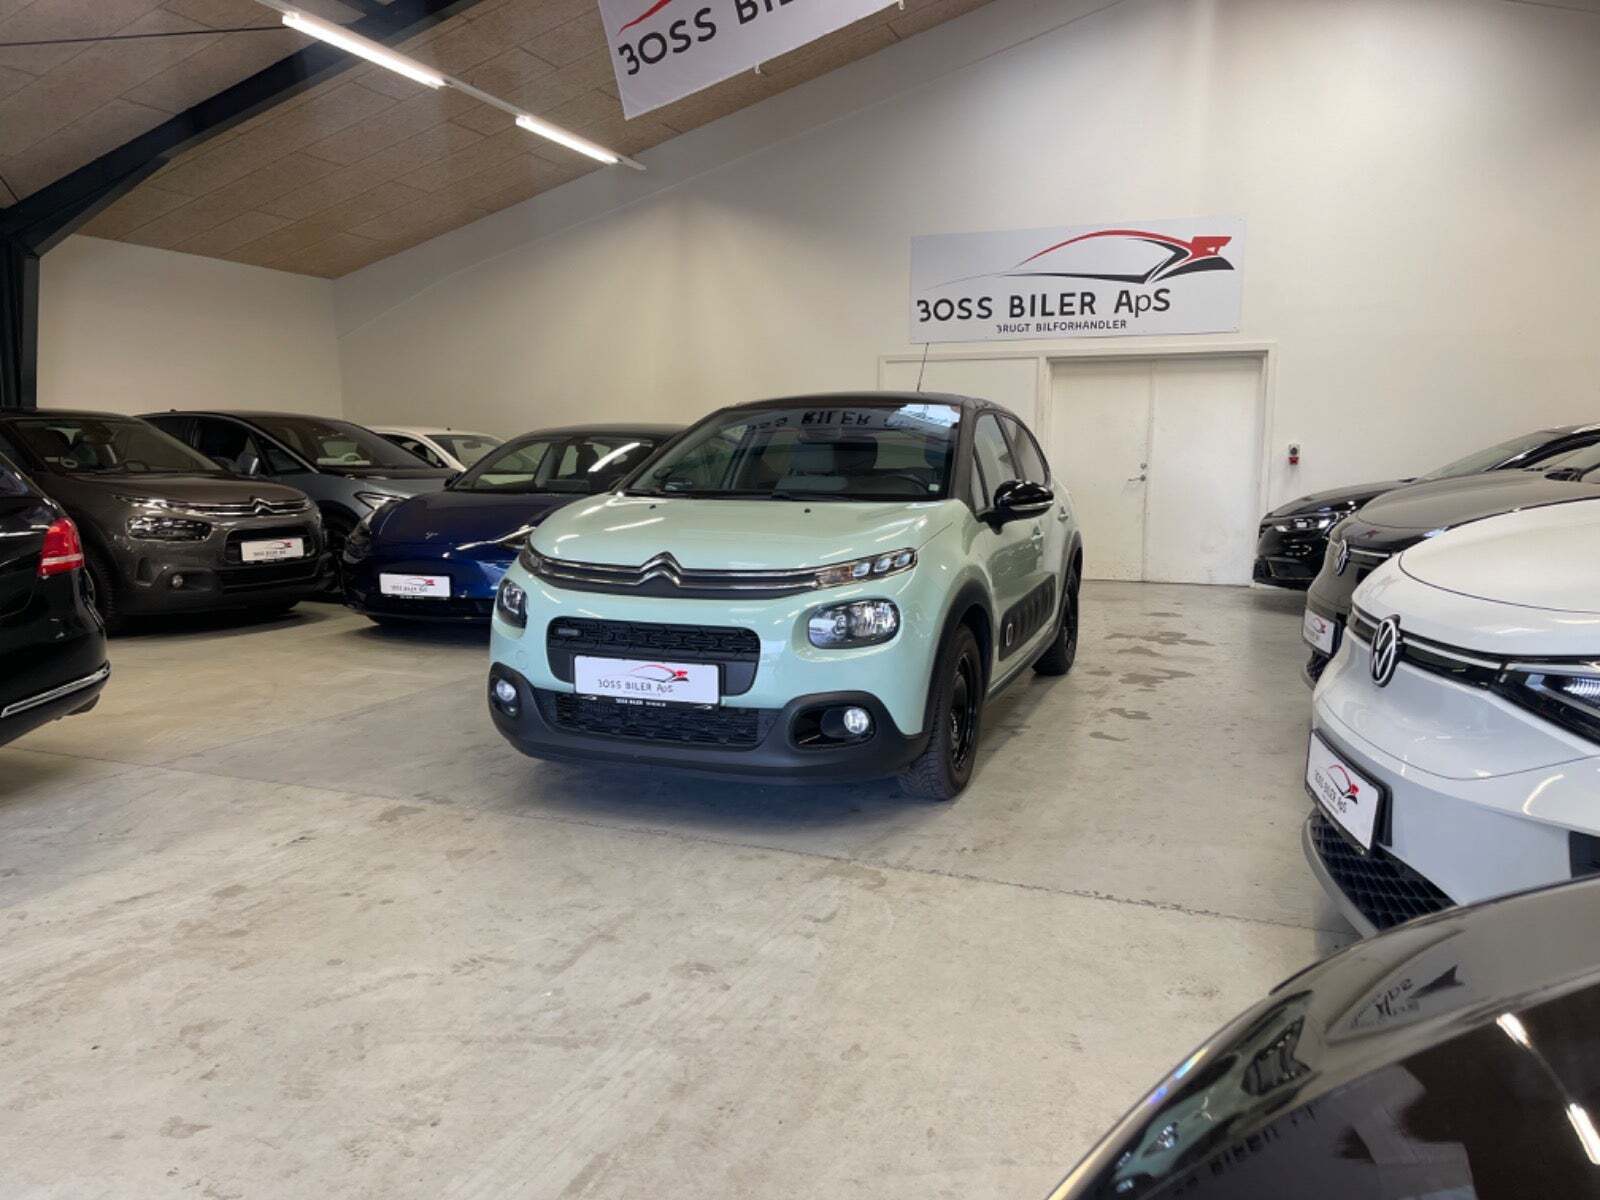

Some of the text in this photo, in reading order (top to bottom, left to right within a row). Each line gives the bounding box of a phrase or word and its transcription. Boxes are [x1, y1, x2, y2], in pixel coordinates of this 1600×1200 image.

[1009, 291, 1096, 319] BILER
[1113, 288, 1171, 318] ApS
[1035, 319, 1127, 333] BILFORHANDLER
[625, 681, 652, 691] BILER
